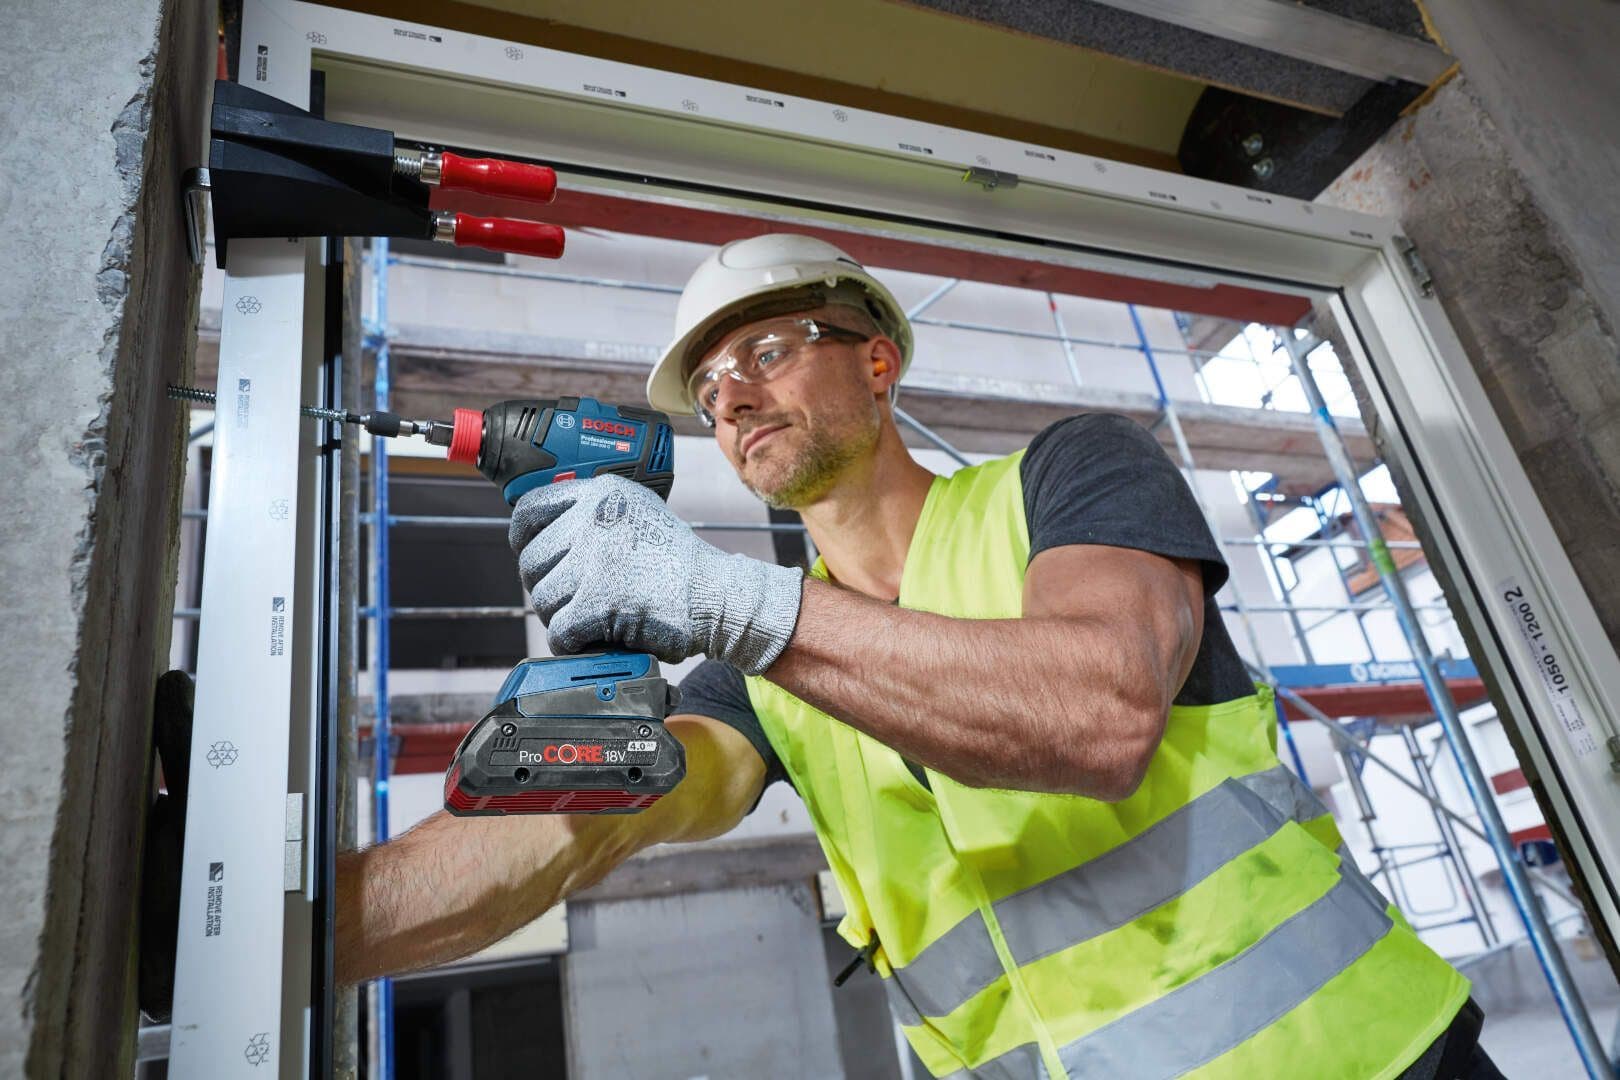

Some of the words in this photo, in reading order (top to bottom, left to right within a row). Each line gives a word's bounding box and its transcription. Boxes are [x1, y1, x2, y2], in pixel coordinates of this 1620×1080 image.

[582, 417, 635, 437] BOSCH
[1504, 586, 1523, 602] 2
[1519, 602, 1543, 641] 1200
[1543, 654, 1569, 695] 1050
[629, 742, 646, 751] 4.0
[206, 886, 215, 937] INSTALLATION
[214, 885, 222, 914] REMOVE
[213, 914, 221, 936] AFTER
